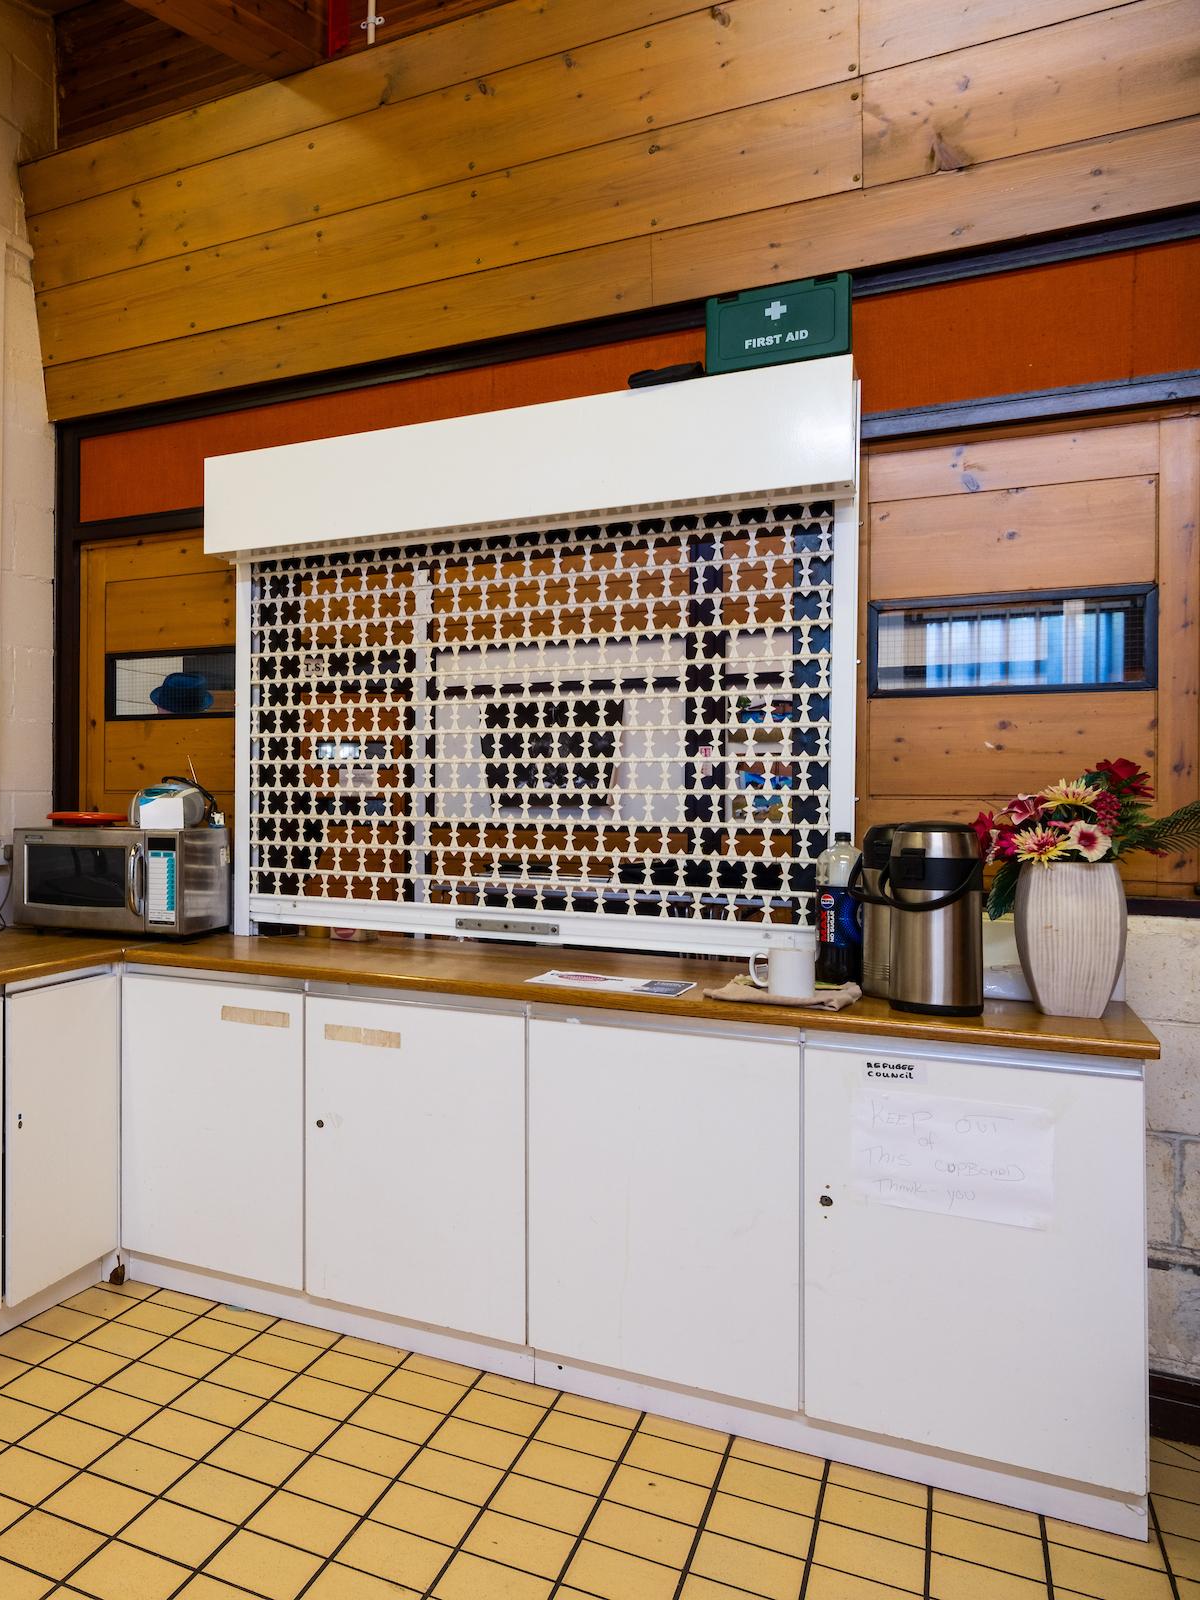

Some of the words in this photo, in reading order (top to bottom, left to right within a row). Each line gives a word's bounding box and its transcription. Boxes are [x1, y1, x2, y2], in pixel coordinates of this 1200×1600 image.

[744, 333, 782, 350] FIRST
[784, 329, 809, 343] AID
[866, 1061, 915, 1071] REFUGEE
[871, 1099, 934, 1135] KEEP
[955, 1114, 1015, 1134] OUT
